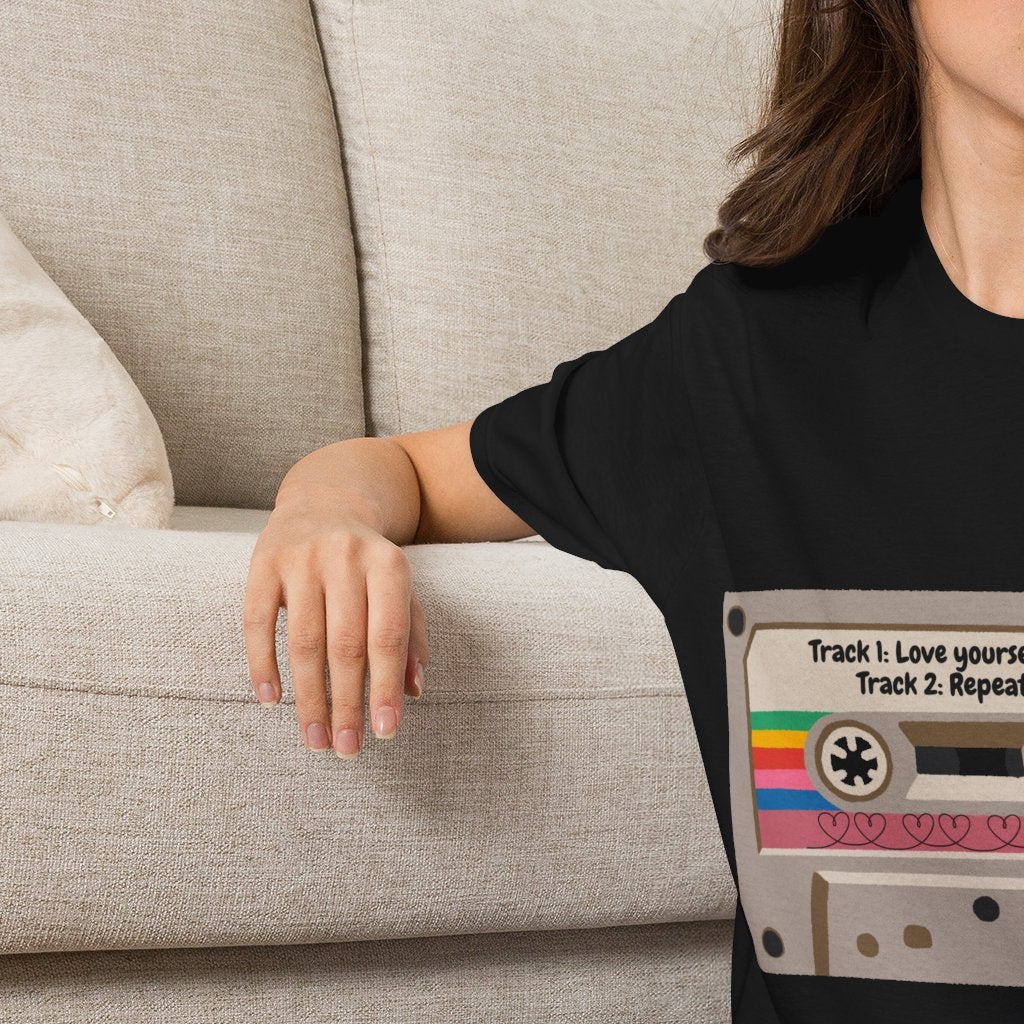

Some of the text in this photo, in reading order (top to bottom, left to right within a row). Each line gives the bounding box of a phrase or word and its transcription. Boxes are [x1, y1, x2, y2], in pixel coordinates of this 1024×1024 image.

[808, 639, 870, 664] Track
[876, 641, 889, 664] 1:
[896, 640, 948, 664] Love
[856, 671, 918, 695] Track
[924, 673, 943, 695] 2:
